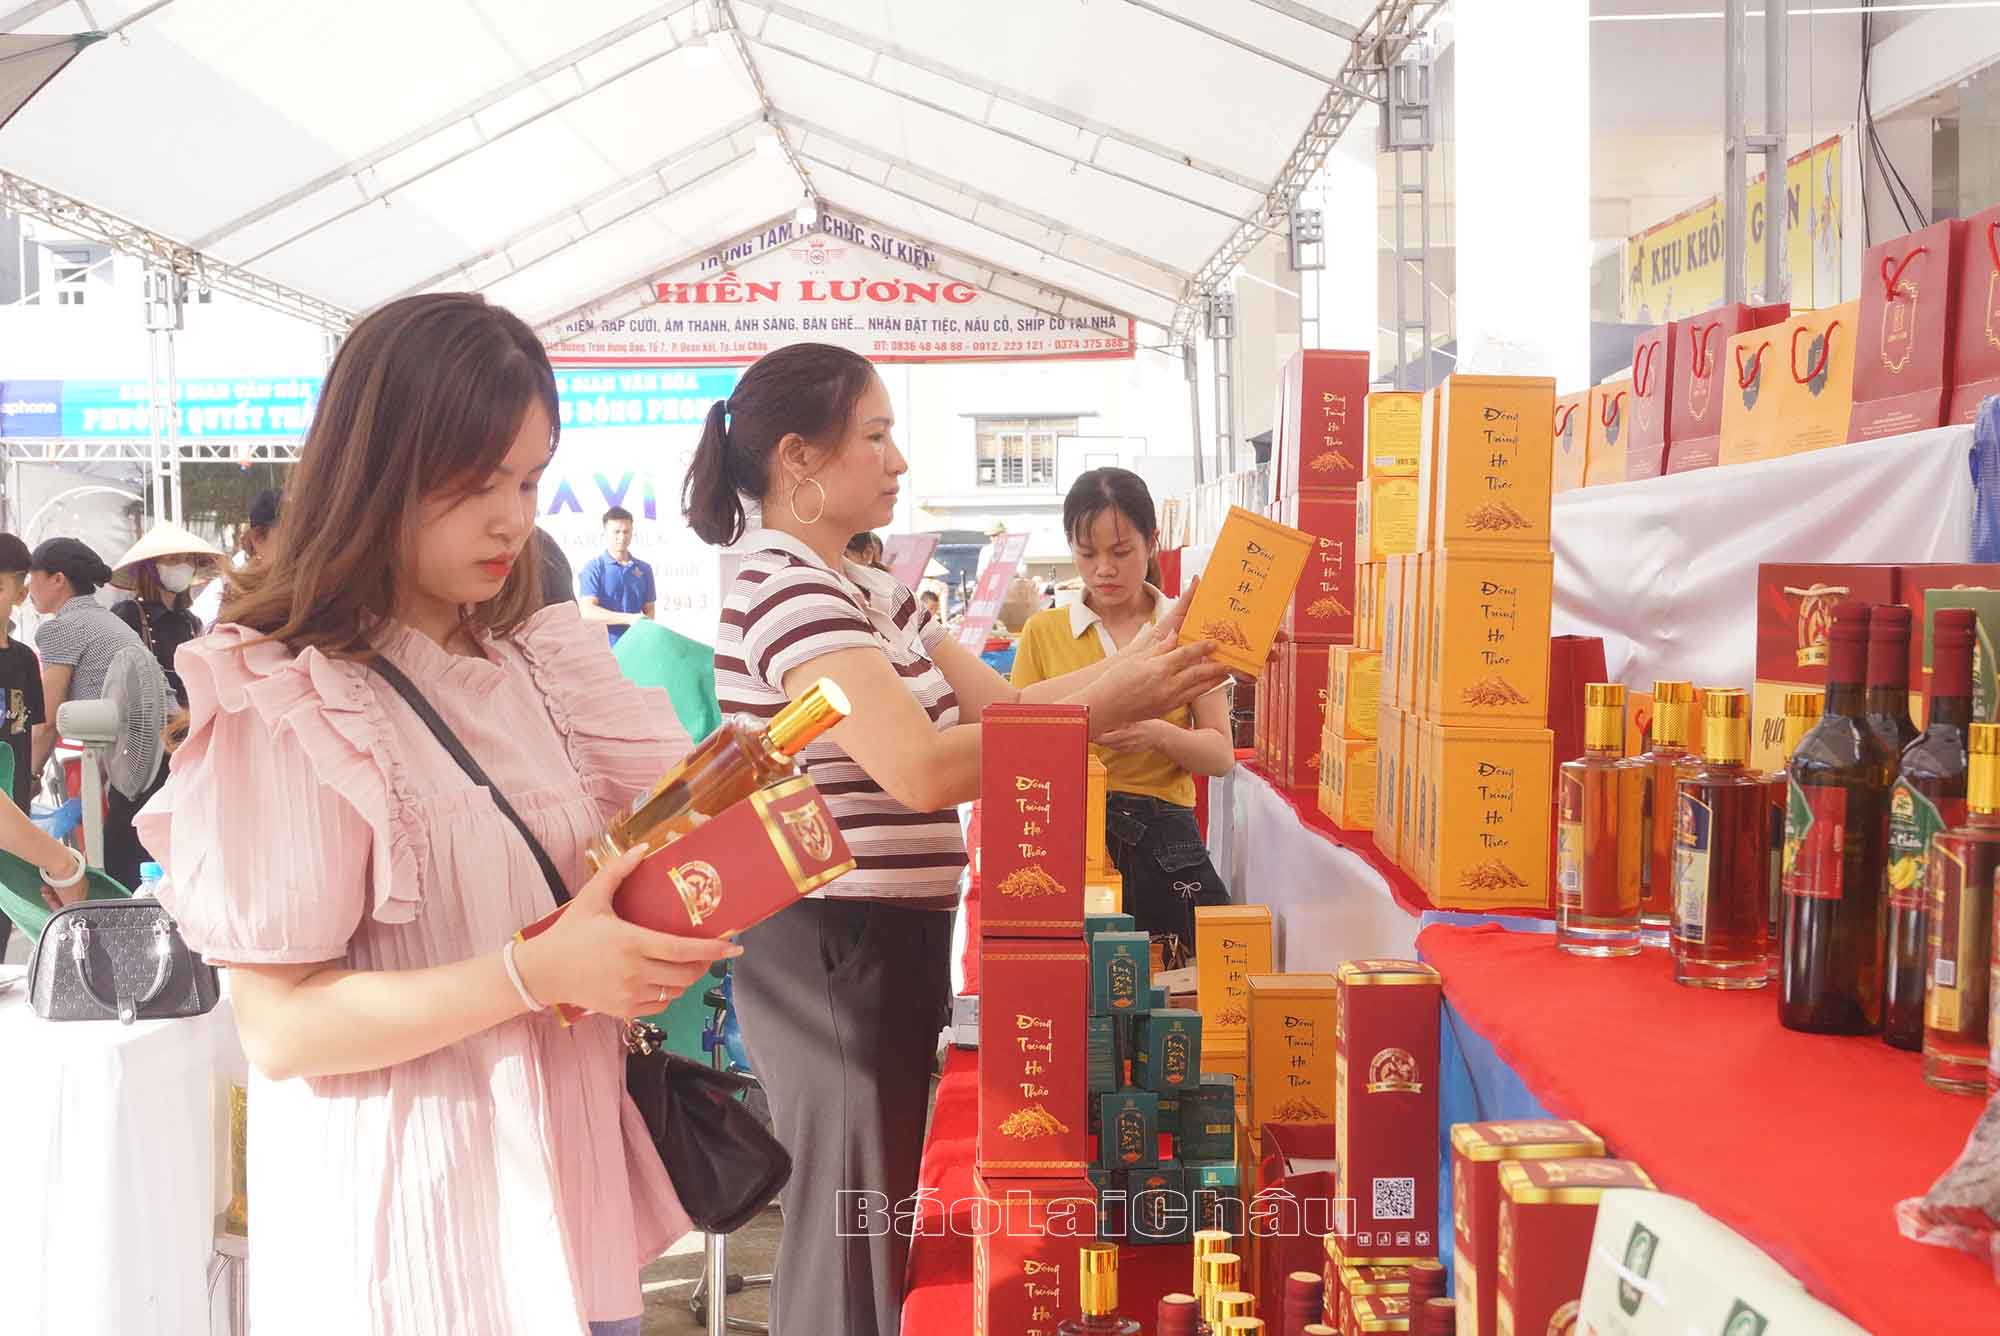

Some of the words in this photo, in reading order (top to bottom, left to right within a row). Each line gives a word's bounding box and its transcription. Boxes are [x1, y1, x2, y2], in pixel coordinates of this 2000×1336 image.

[1651, 239, 1682, 286] KHU
[655, 270, 782, 305] HIỀN
[799, 277, 977, 304] LƯƠNG
[1016, 318, 1046, 333] SHIP
